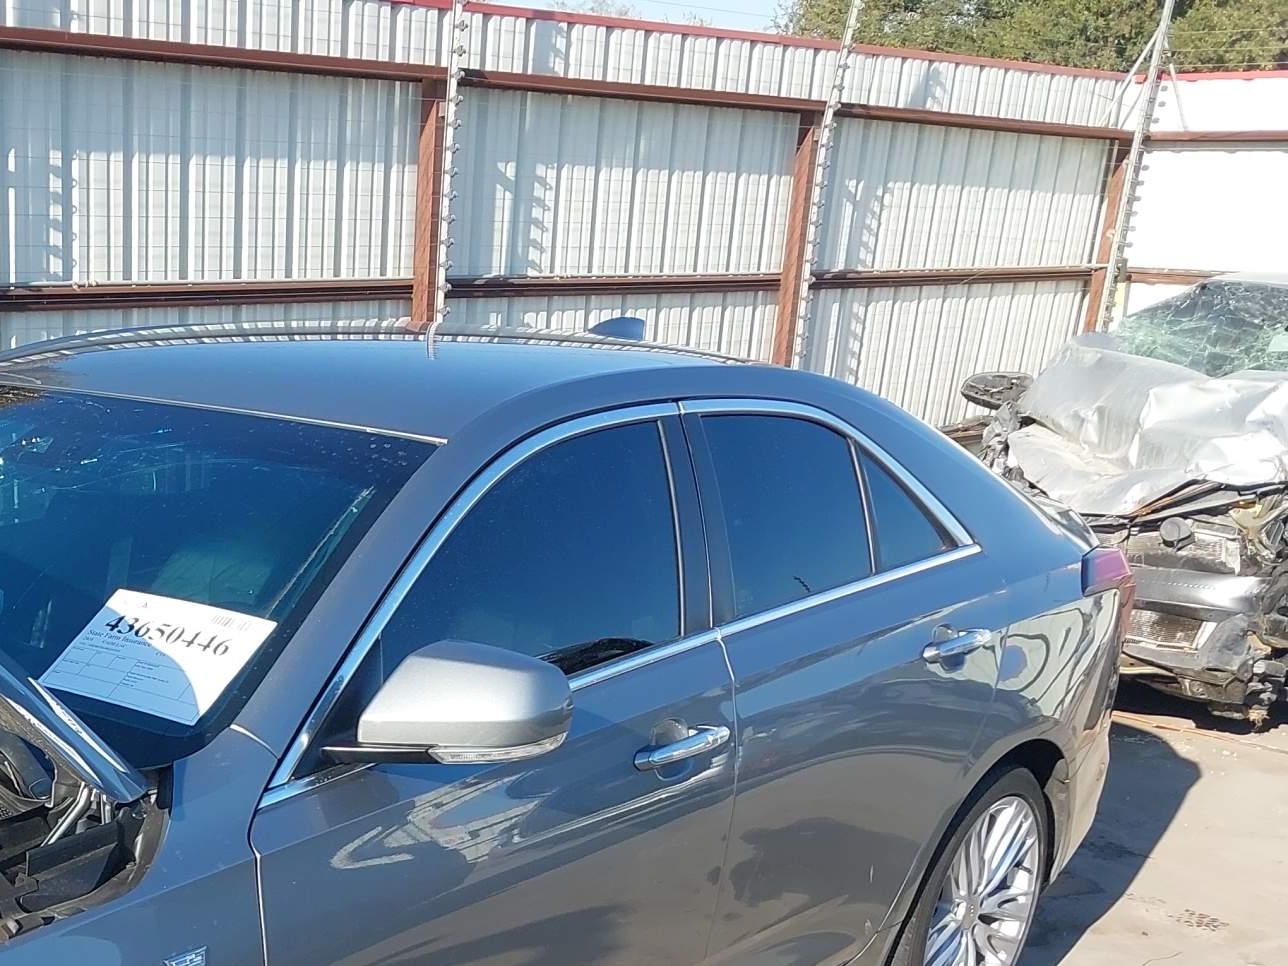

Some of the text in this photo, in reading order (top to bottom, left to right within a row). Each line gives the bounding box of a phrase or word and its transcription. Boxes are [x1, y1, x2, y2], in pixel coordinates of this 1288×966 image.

[87, 629, 104, 638] State
[104, 631, 121, 642] Farm
[120, 635, 152, 647] Insurance
[105, 615, 232, 657] 43650446
